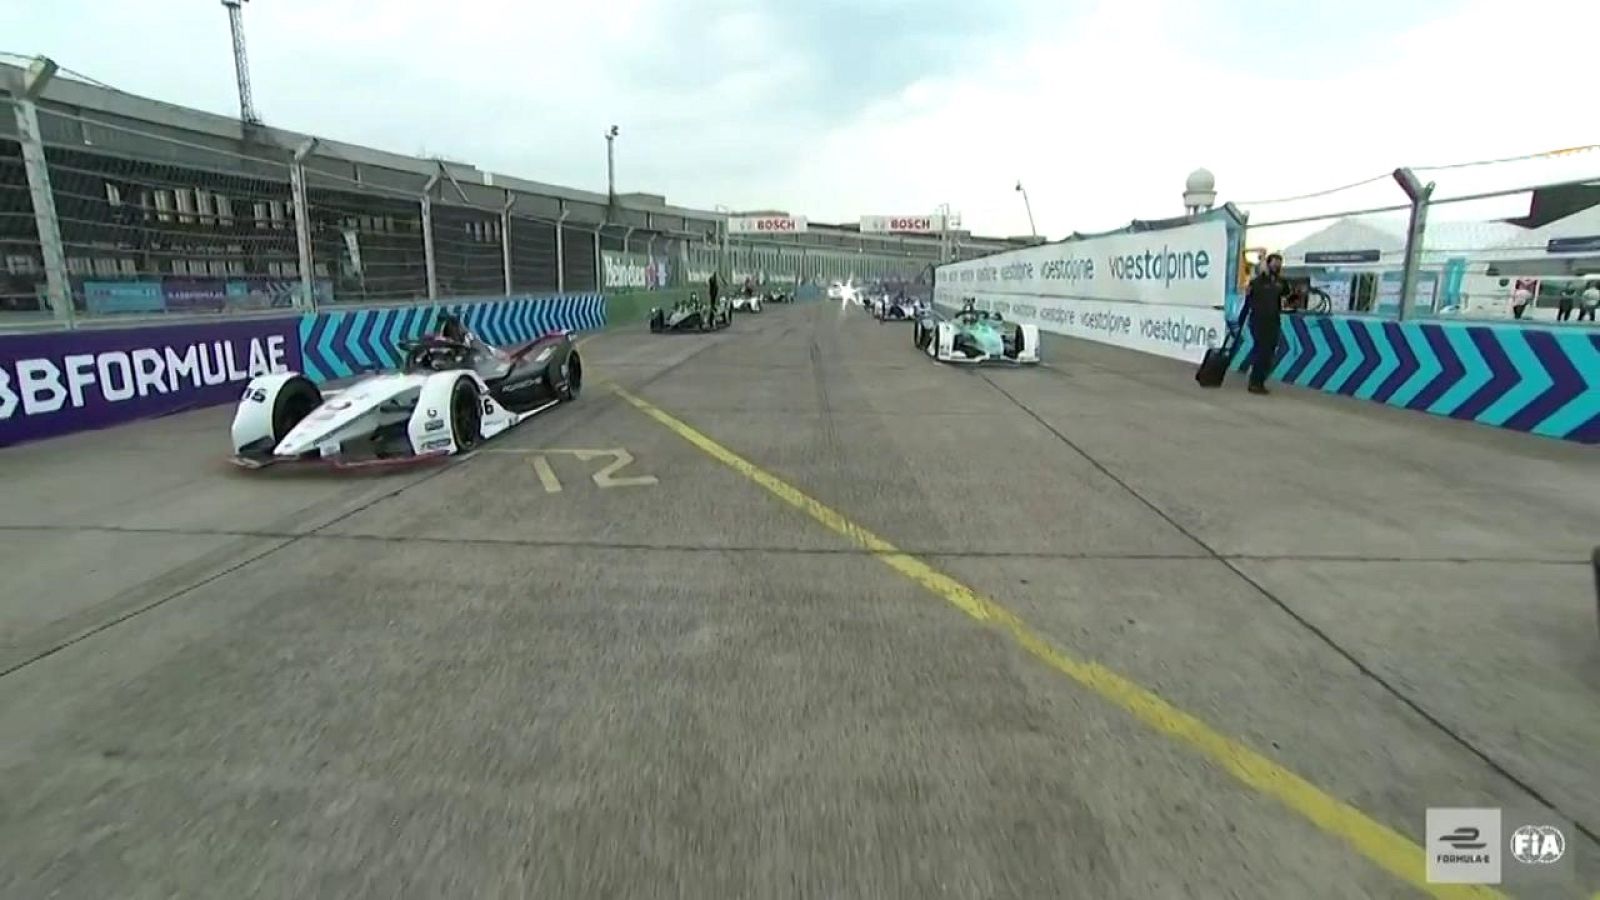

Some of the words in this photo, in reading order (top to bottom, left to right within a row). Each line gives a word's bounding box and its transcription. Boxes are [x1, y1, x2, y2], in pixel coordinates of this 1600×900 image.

[757, 219, 796, 231] BOSCH
[890, 216, 930, 230] BOSCH
[1109, 244, 1210, 289] voestalpine
[1139, 315, 1218, 349] voestalpine
